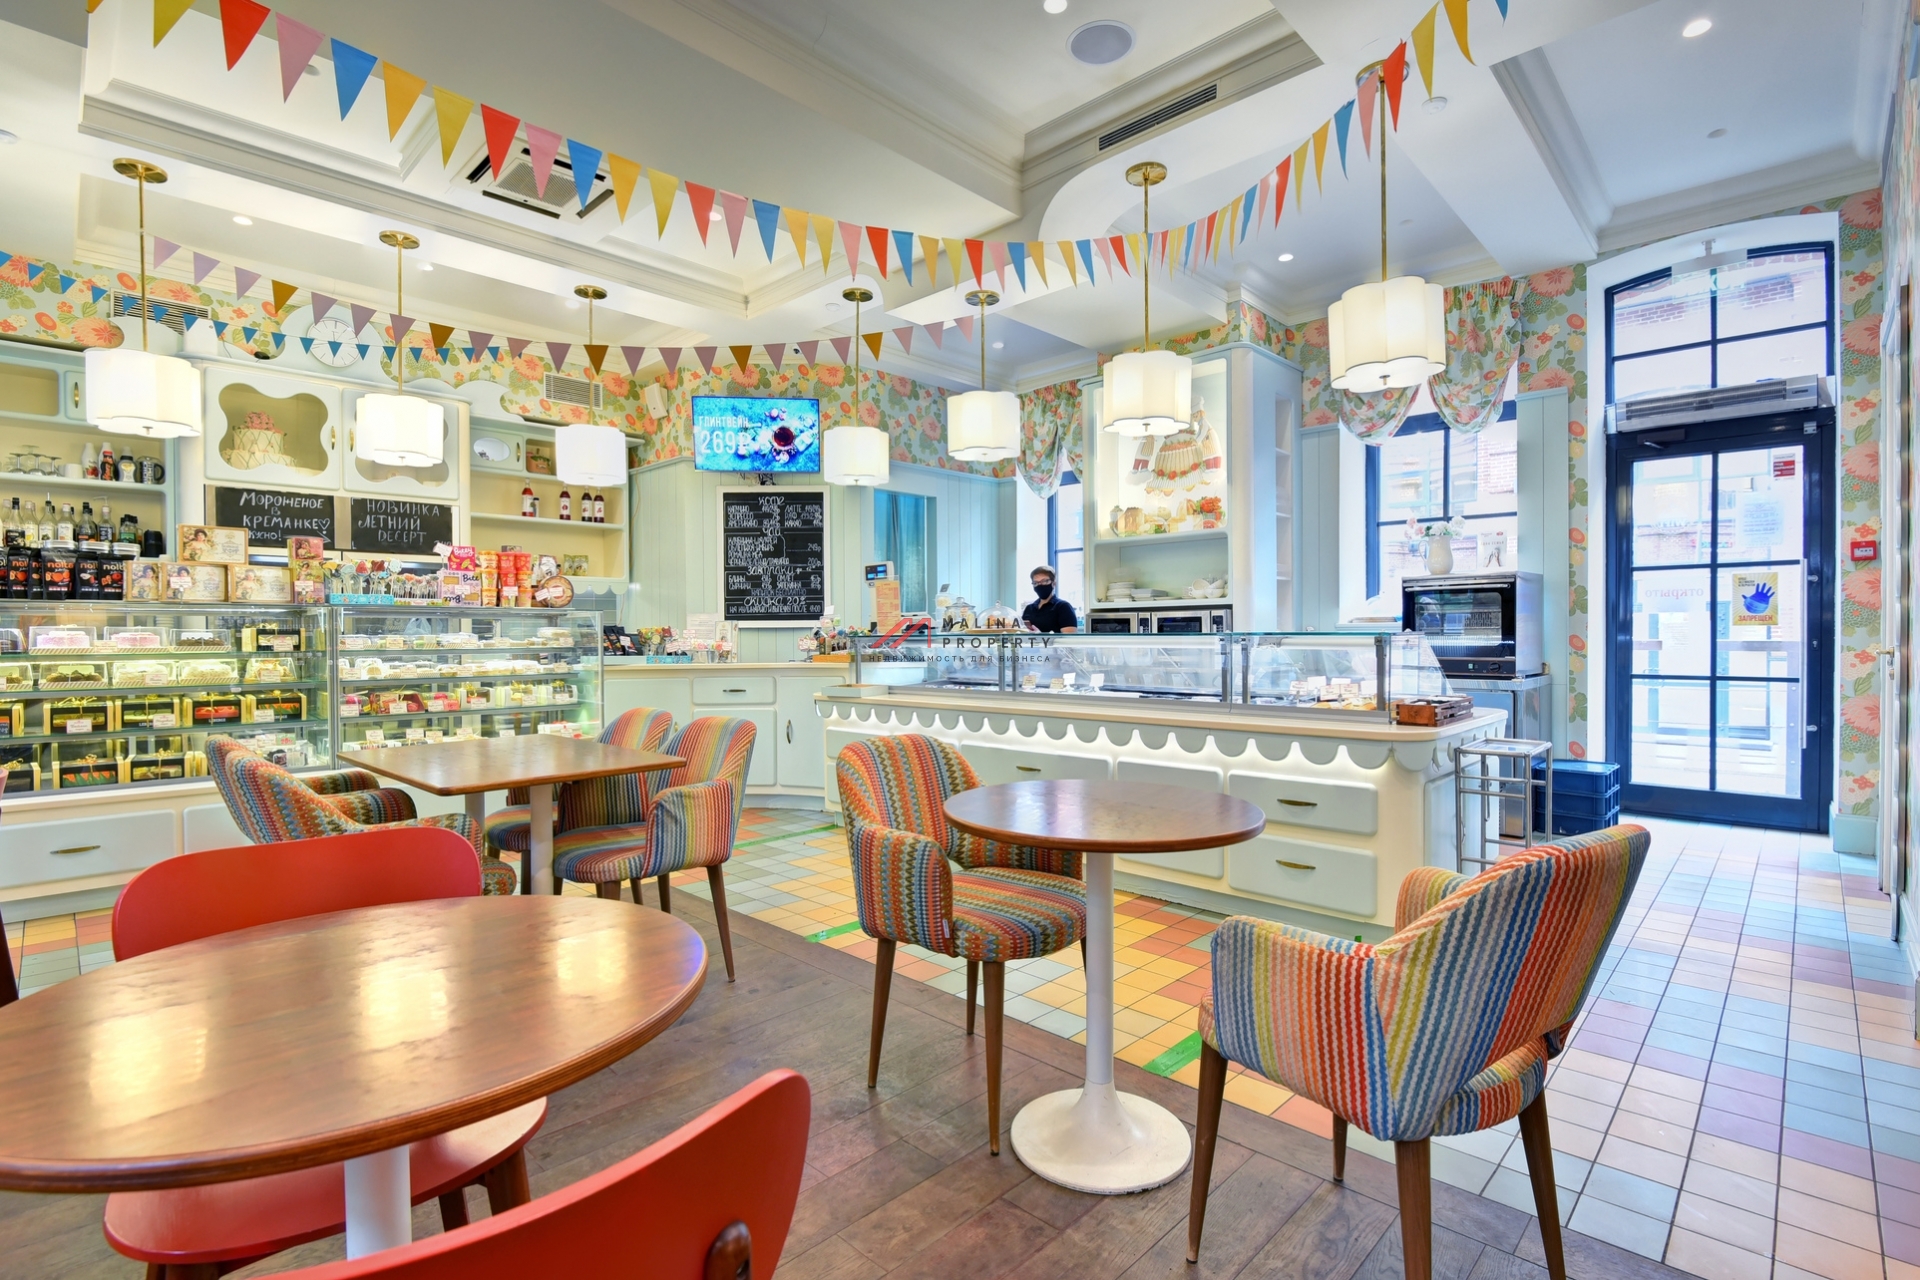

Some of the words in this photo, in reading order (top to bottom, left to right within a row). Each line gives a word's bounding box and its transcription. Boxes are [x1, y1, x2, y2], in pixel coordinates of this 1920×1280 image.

[698, 414, 749, 428] ГЛИНТВЕЙН
[366, 500, 441, 517] НОВИНКА
[242, 514, 319, 530] КРЕМАНКЕ
[358, 514, 421, 532] ЛЕТНИЙ
[248, 529, 282, 541] КУСНО!
